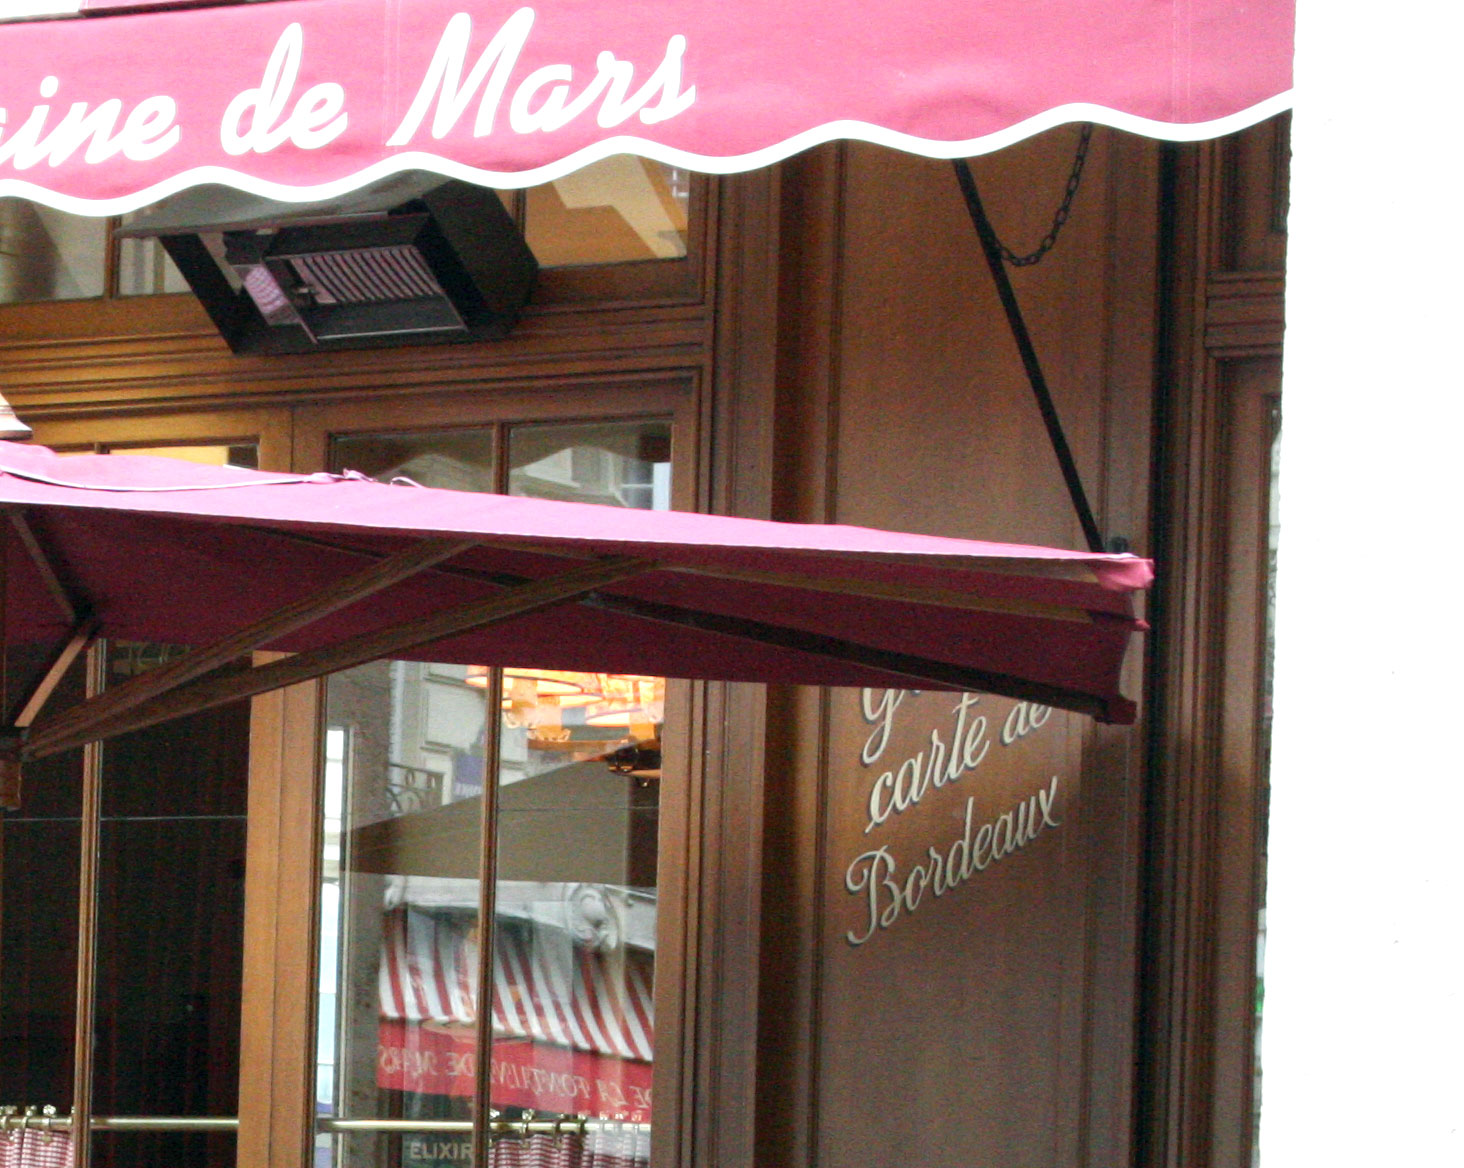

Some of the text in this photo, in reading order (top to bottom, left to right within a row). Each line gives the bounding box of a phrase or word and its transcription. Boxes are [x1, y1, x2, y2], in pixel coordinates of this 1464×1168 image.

[220, 22, 348, 156] de
[386, 7, 697, 146] Mars
[865, 692, 990, 834] carte
[845, 775, 1061, 945] Bordeaux
[410, 1141, 473, 1160] ELIXIR
